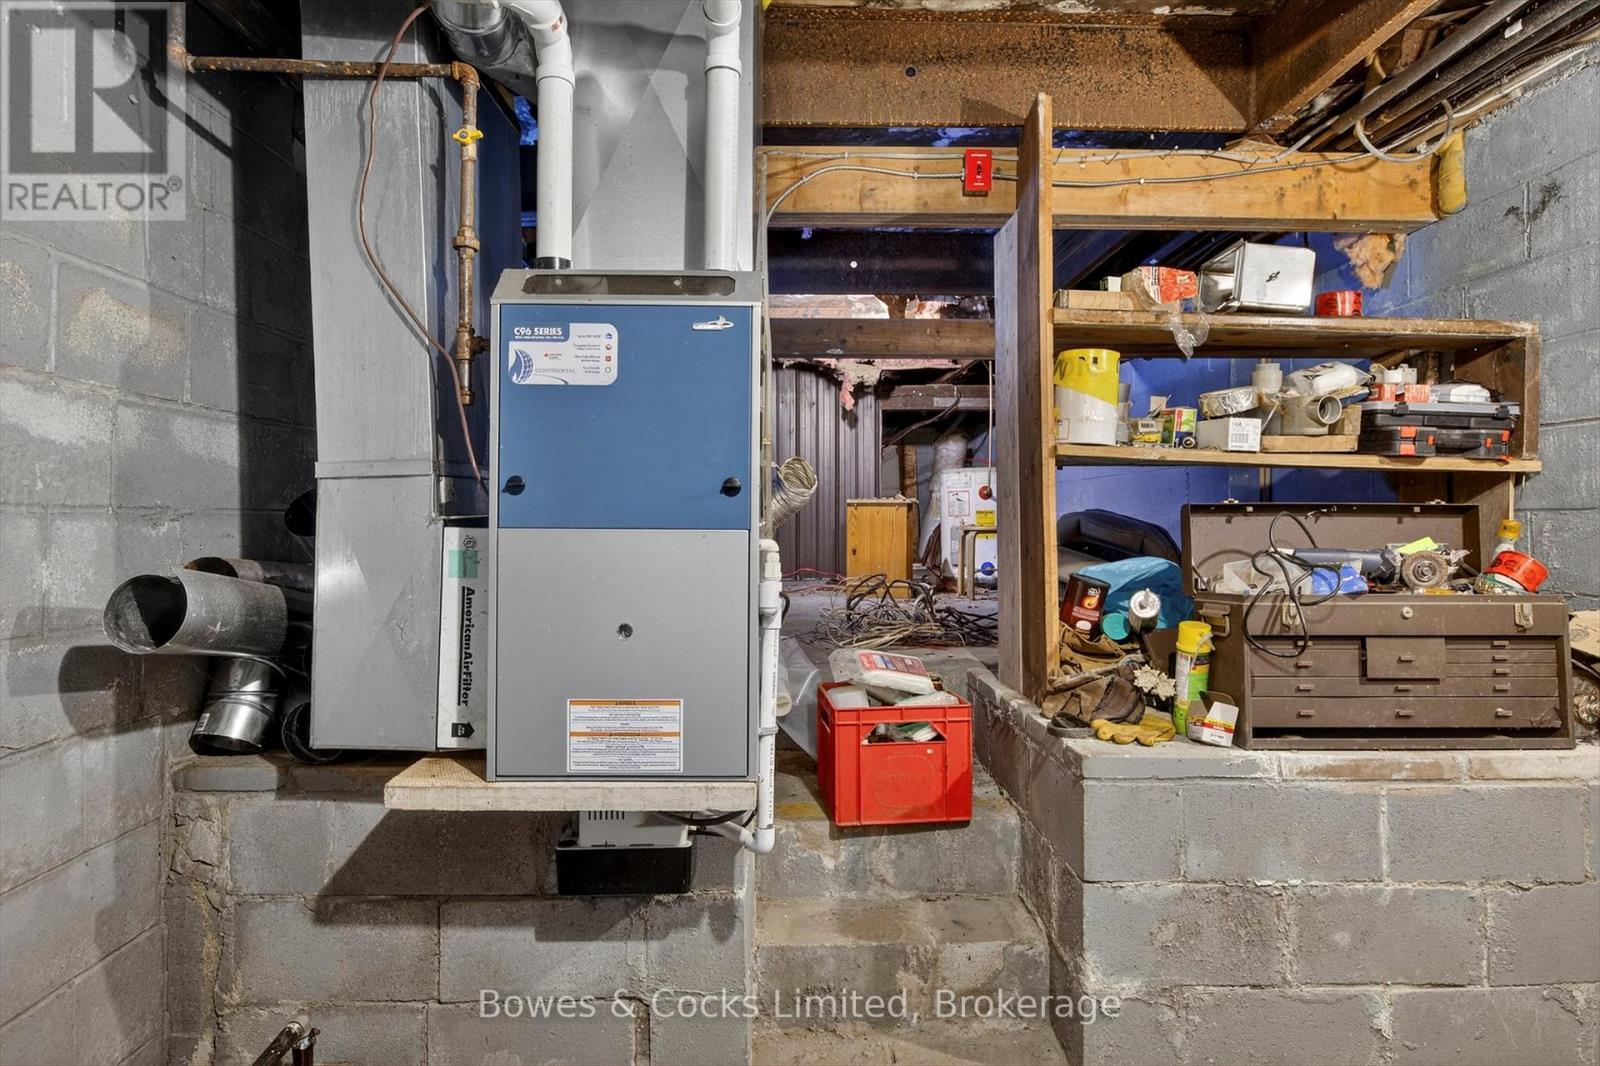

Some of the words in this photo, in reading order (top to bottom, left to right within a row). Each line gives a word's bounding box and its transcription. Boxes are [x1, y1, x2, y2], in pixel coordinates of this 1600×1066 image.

[513, 327, 532, 336] C96
[533, 327, 563, 336] SERIES
[461, 586, 476, 706] AmericanAirFilter
